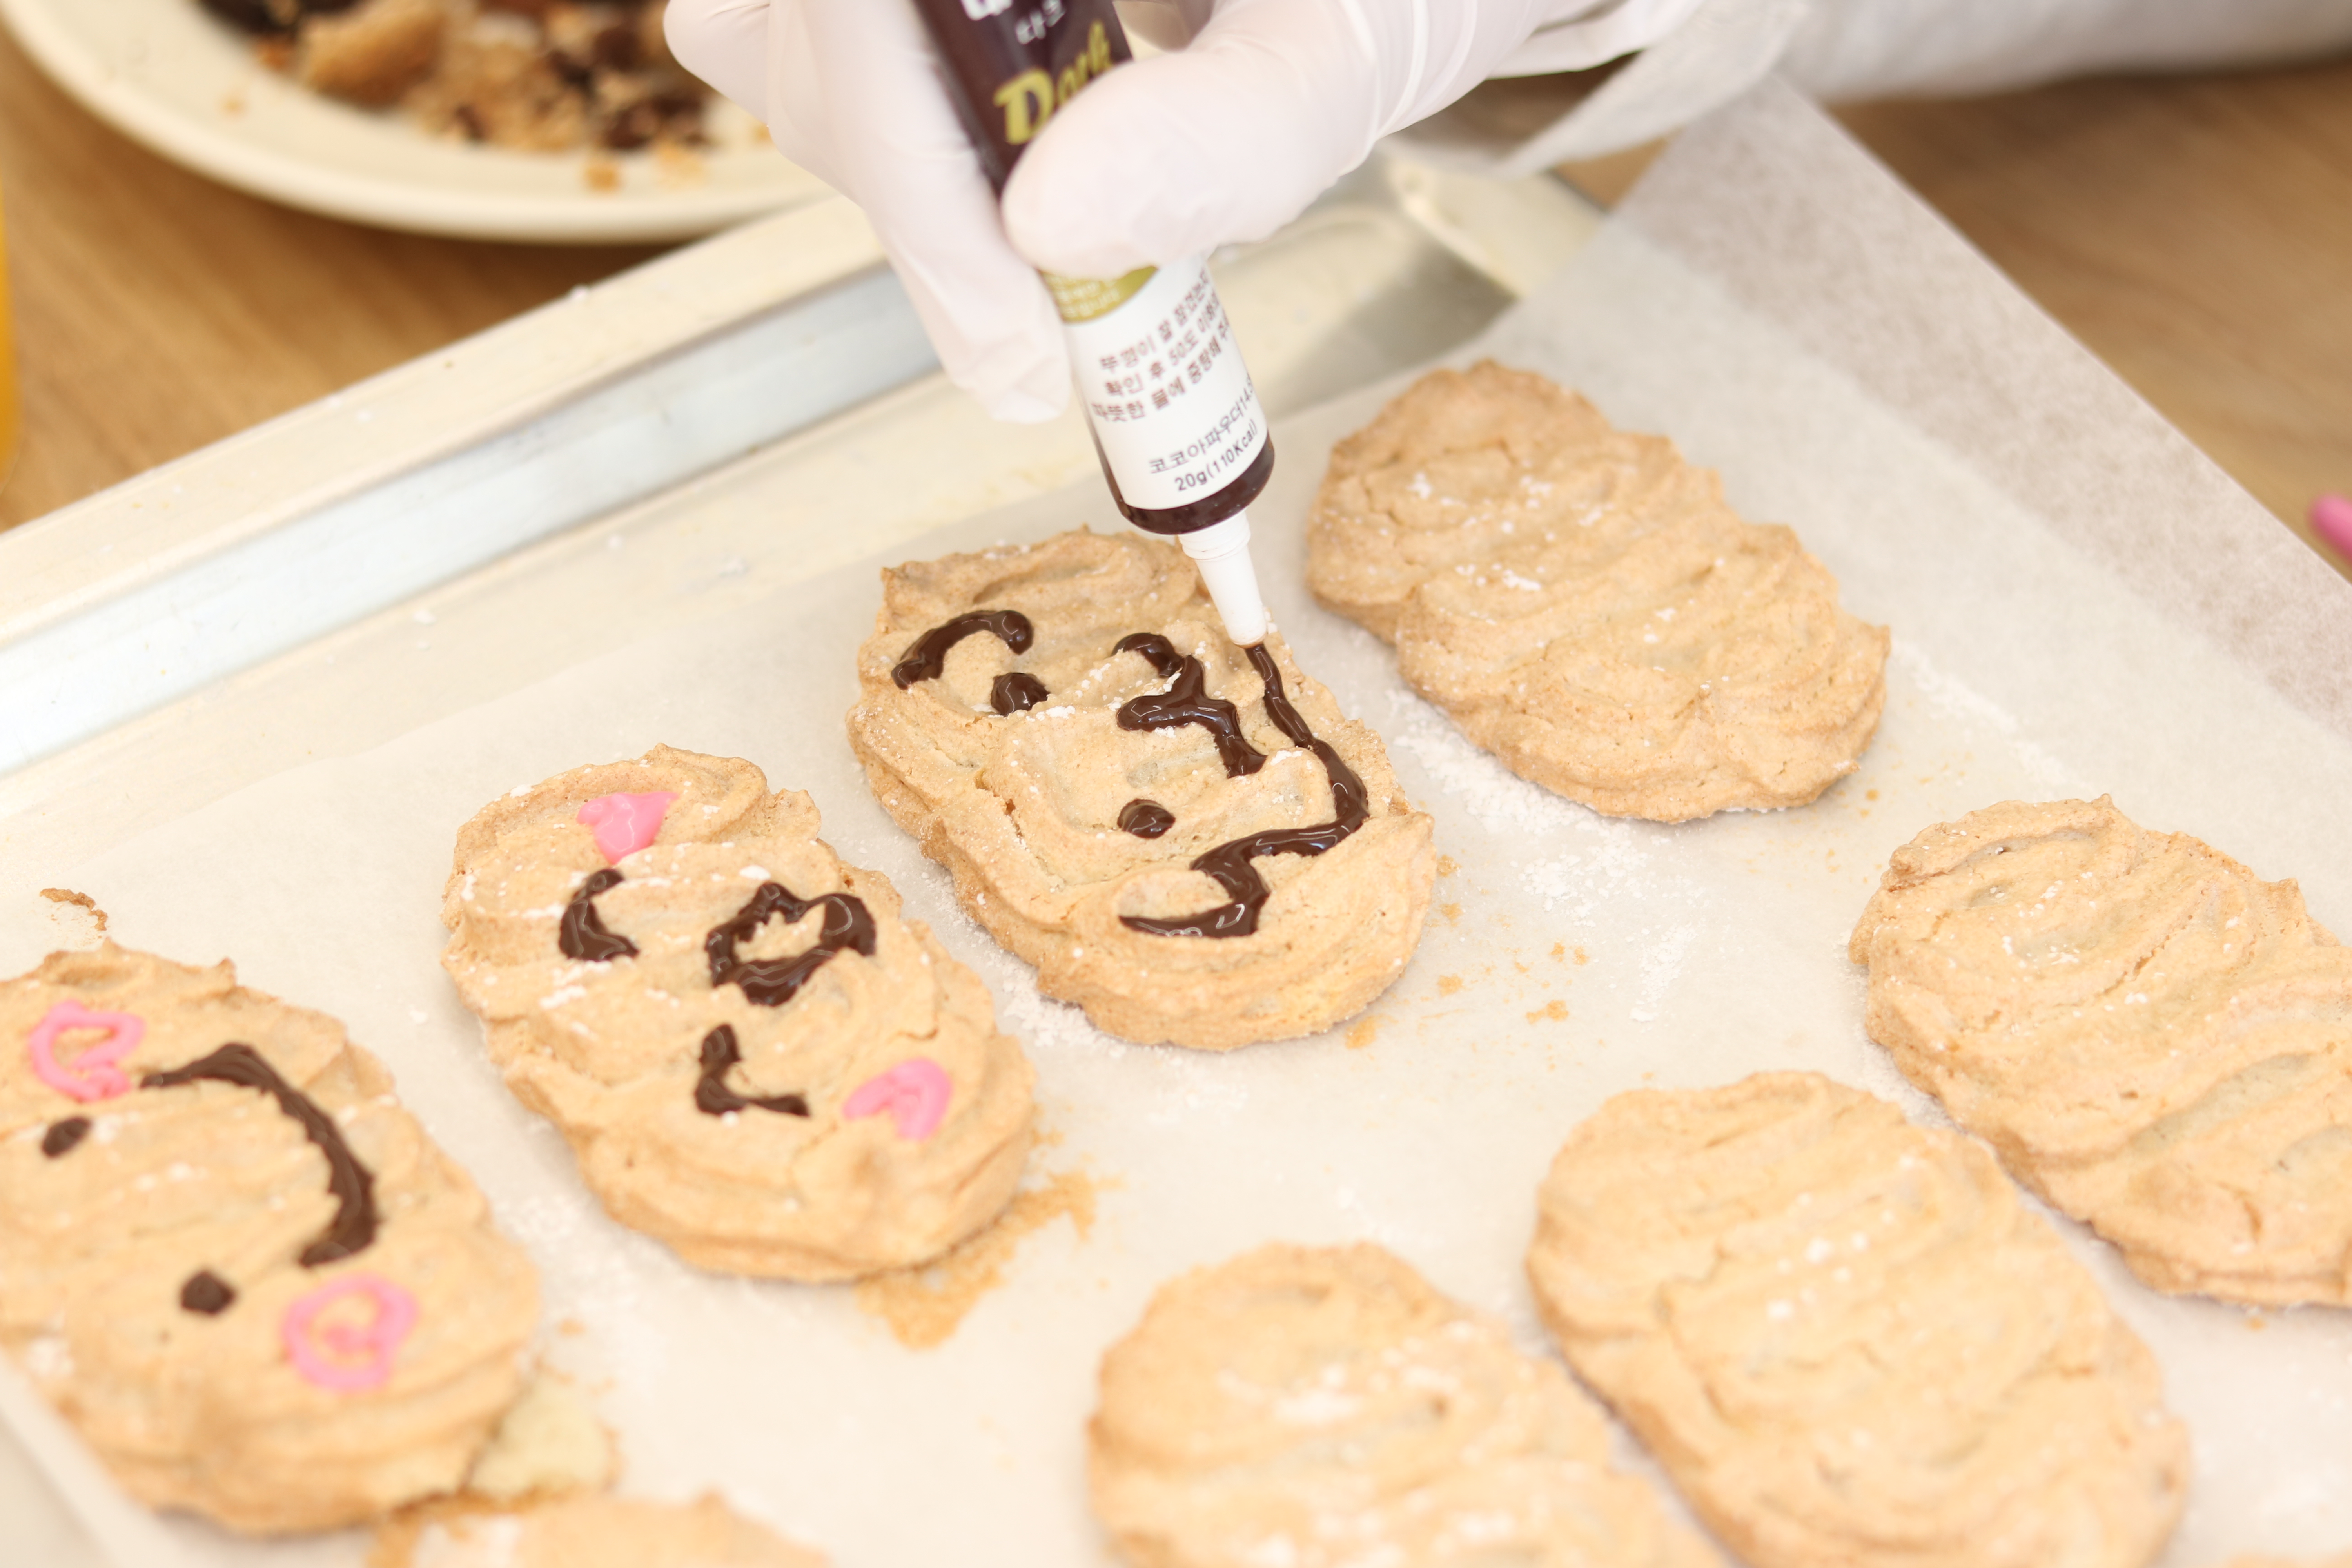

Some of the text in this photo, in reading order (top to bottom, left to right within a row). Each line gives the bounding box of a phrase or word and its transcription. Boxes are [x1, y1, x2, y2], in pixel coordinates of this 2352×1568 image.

[1100, 334, 1156, 373] 뚜껑이
[1158, 319, 1172, 343] 잘
[1106, 372, 1144, 397] 확인
[1150, 361, 1166, 379] 후
[1169, 329, 1199, 365] 50도
[1091, 401, 1145, 421] 따뜻한
[1151, 376, 1185, 410] 물에
[1175, 418, 1258, 491] 20g(110Kcal)
